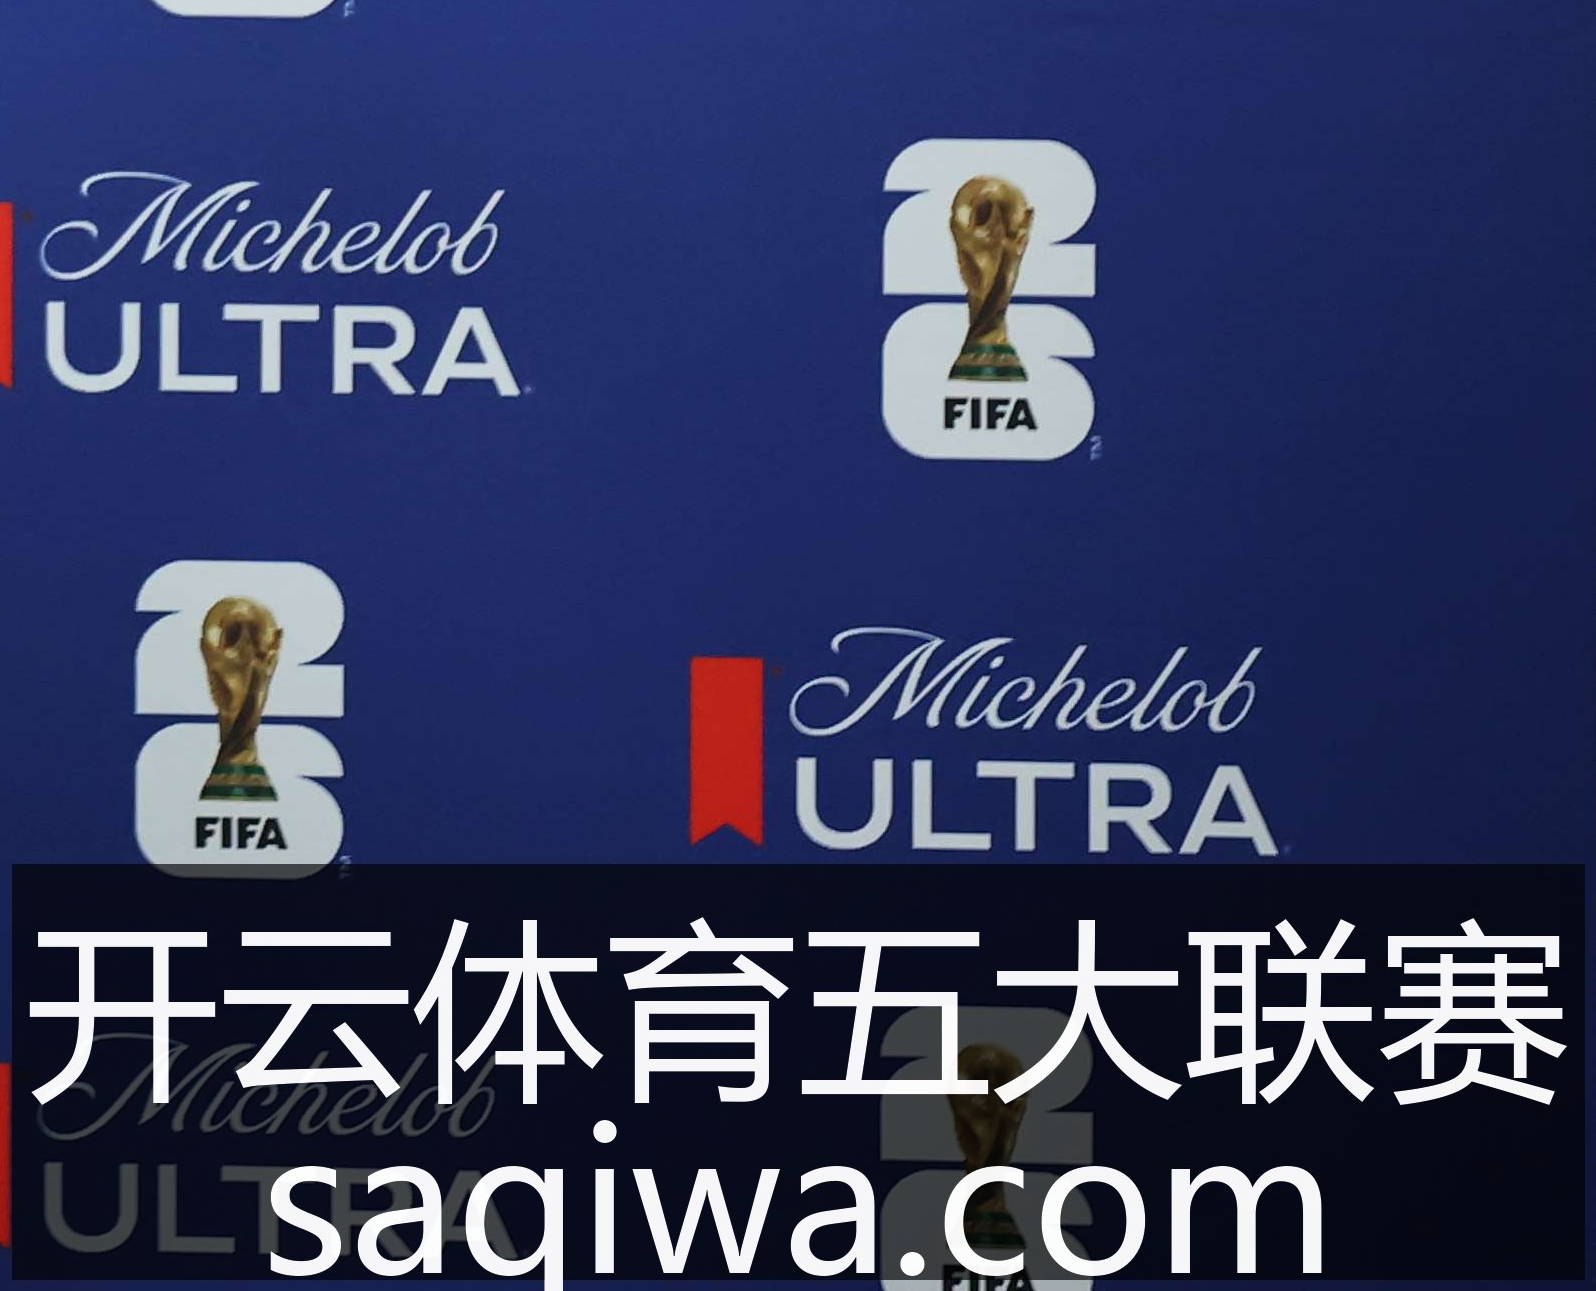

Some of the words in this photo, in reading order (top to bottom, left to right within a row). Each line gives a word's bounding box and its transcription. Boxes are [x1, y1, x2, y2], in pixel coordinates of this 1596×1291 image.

[40, 171, 505, 281] Michelob
[45, 300, 521, 397] ULTRA
[944, 397, 1038, 431] FIFA
[789, 626, 1263, 737] Michelob
[195, 816, 288, 848] FIFA
[795, 756, 1279, 857] ULTRA
